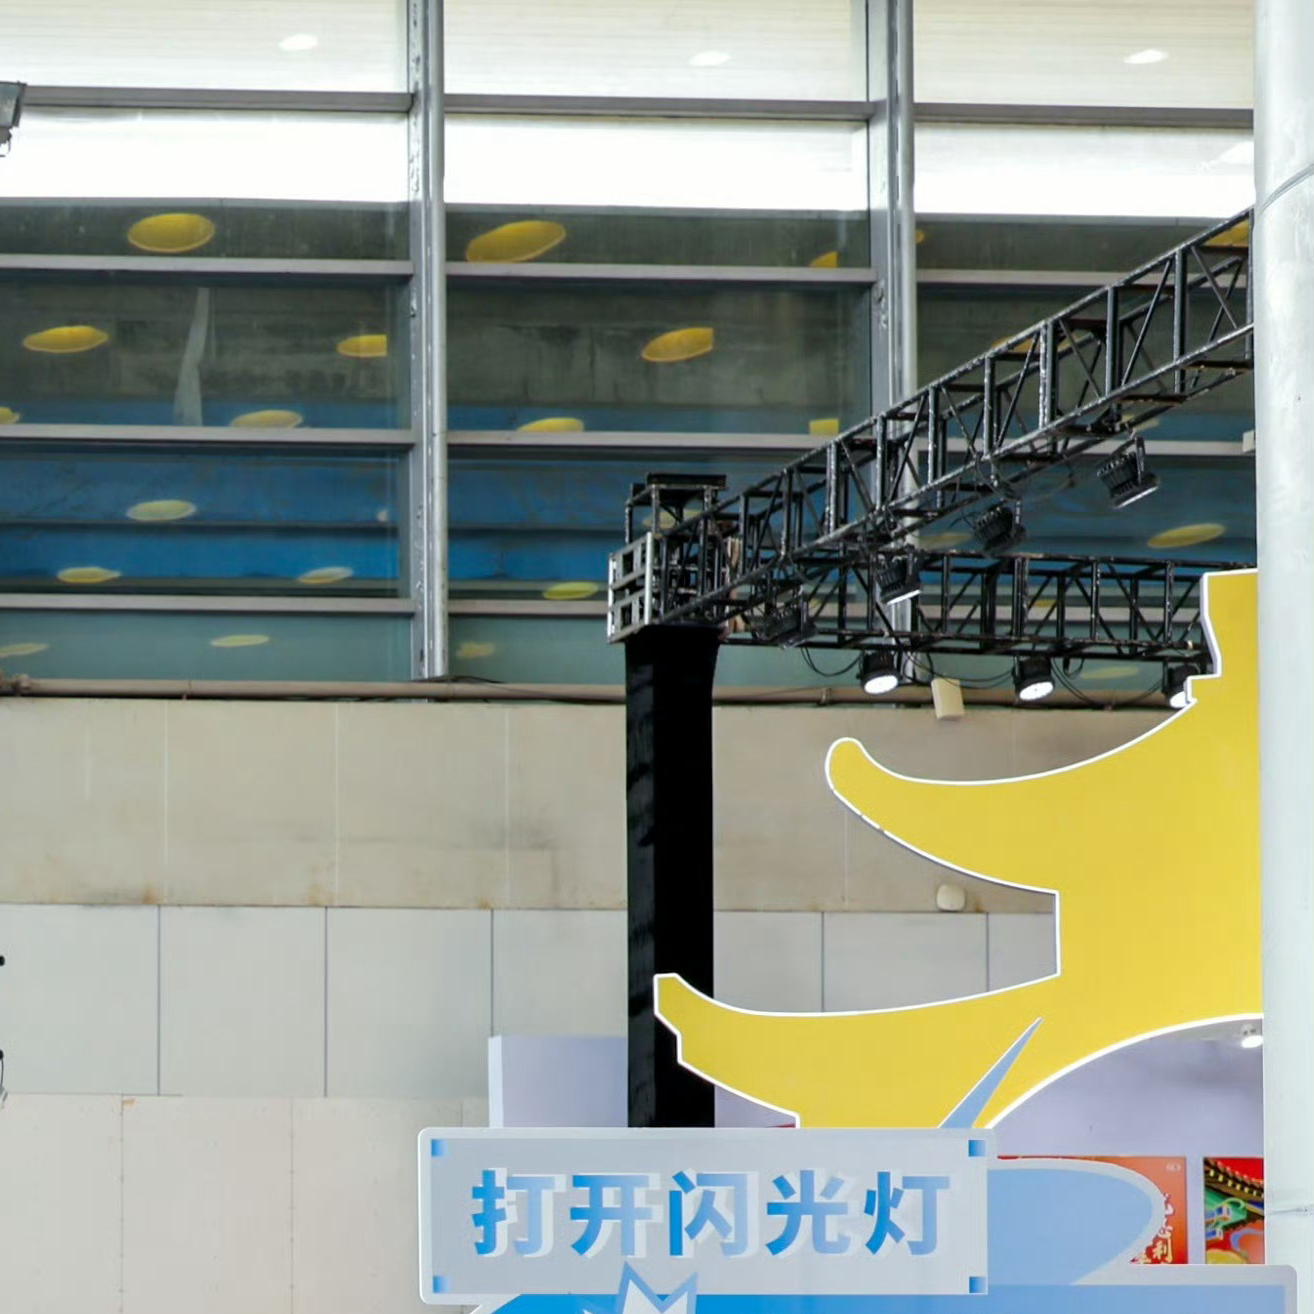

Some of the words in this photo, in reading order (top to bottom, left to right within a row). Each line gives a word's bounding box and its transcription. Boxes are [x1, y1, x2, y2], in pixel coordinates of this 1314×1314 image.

[470, 1167, 952, 1259] 打开闪光灯
